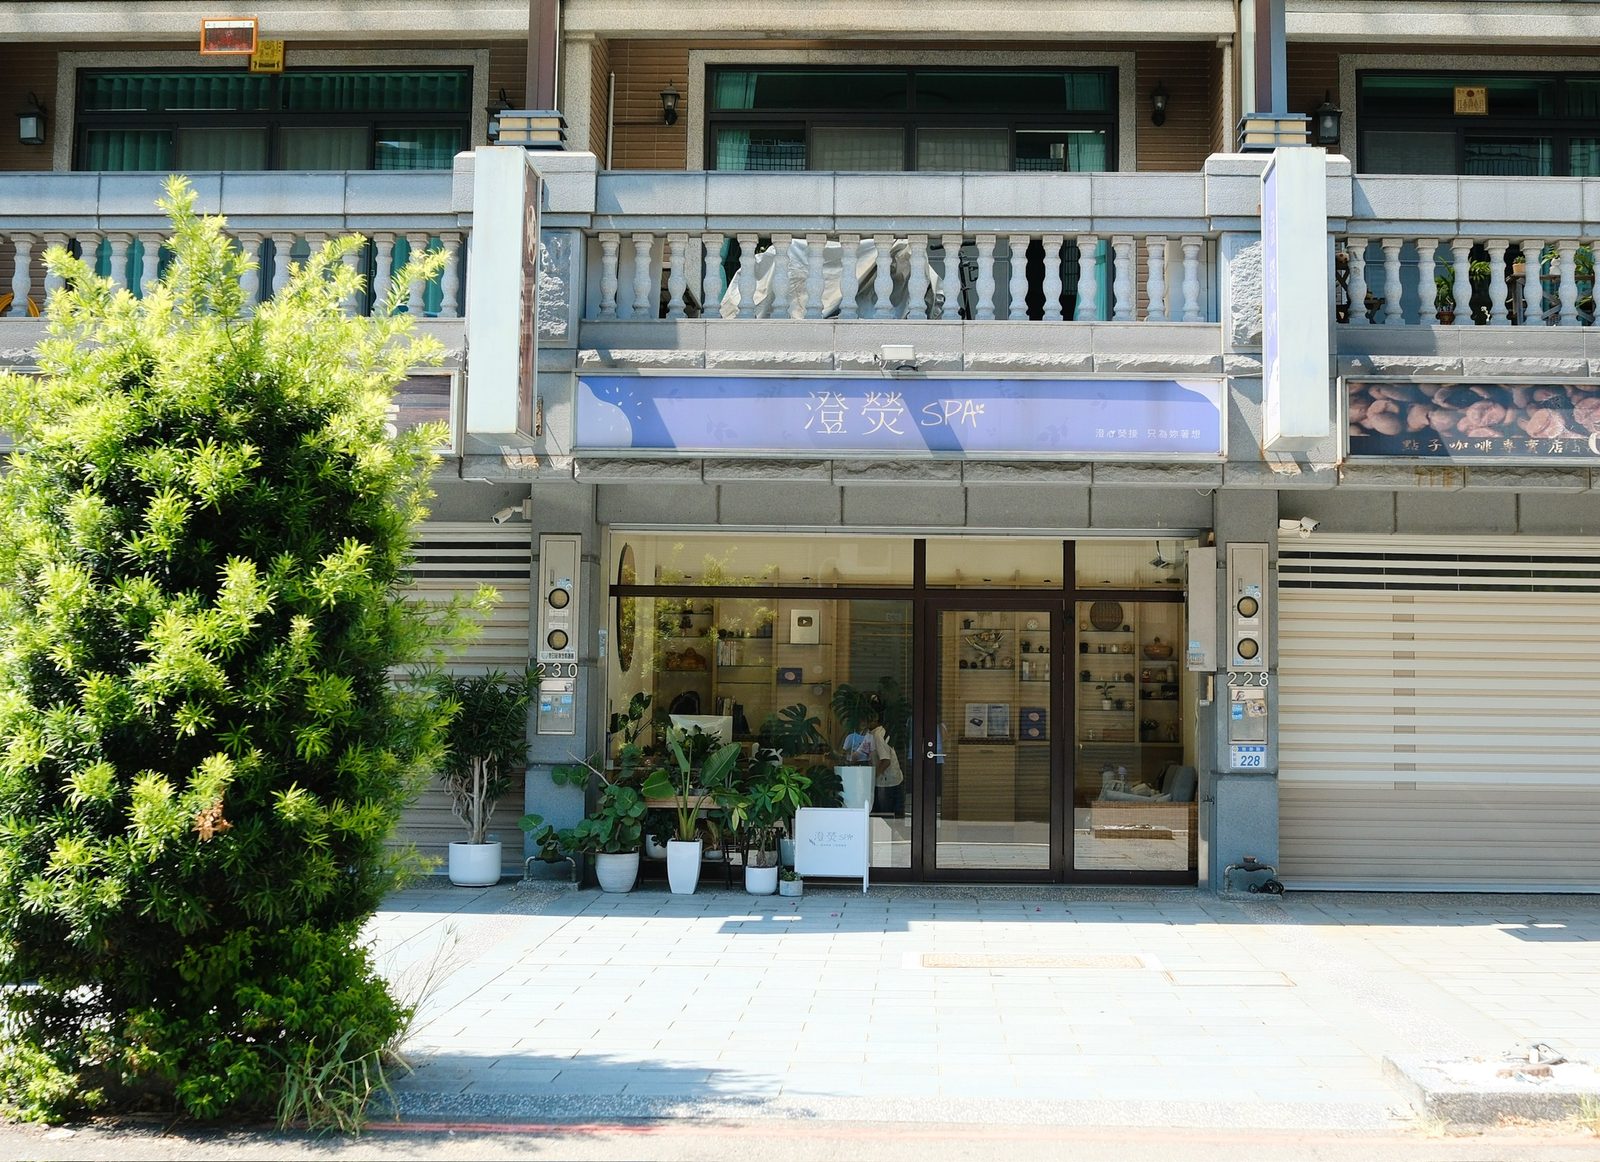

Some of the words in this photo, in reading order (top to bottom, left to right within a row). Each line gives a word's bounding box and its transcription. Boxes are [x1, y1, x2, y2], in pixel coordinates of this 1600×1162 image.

[803, 391, 905, 436] 澄熒
[920, 399, 977, 428] SPA
[1402, 438, 1564, 454] 點子咖啡專賣店
[537, 662, 578, 678] 230
[1227, 671, 1269, 687] 228
[1240, 755, 1261, 767] 228
